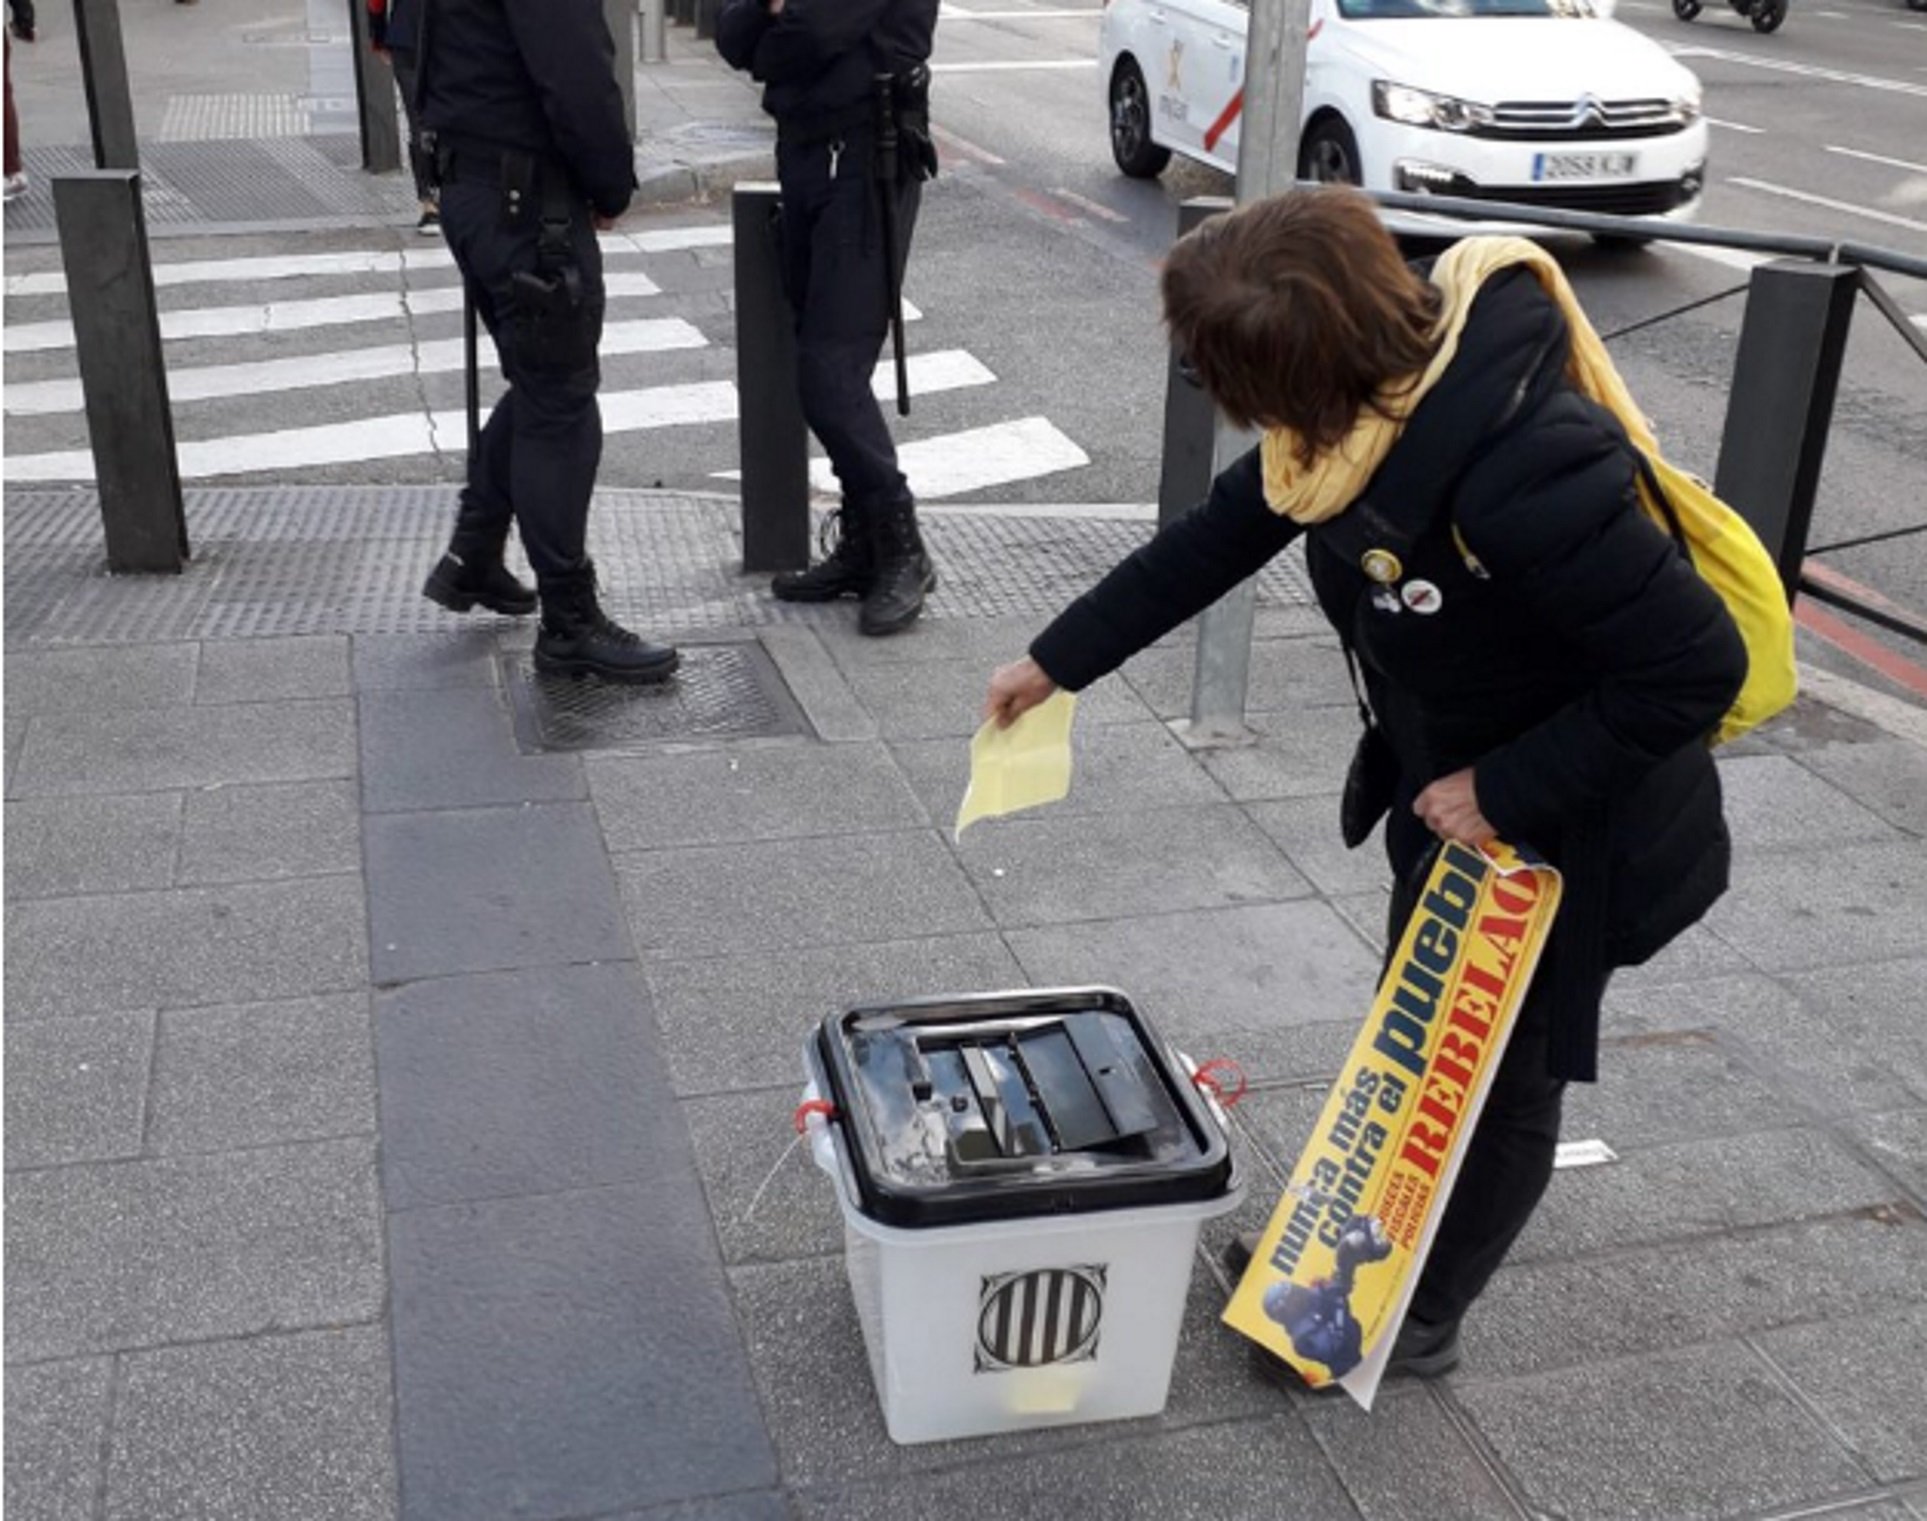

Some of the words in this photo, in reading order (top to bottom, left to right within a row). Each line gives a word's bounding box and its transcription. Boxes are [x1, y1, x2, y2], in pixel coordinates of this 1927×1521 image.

[1318, 1121, 1388, 1250] contra
[1378, 1071, 1407, 1114] el
[1327, 1066, 1380, 1153] más
